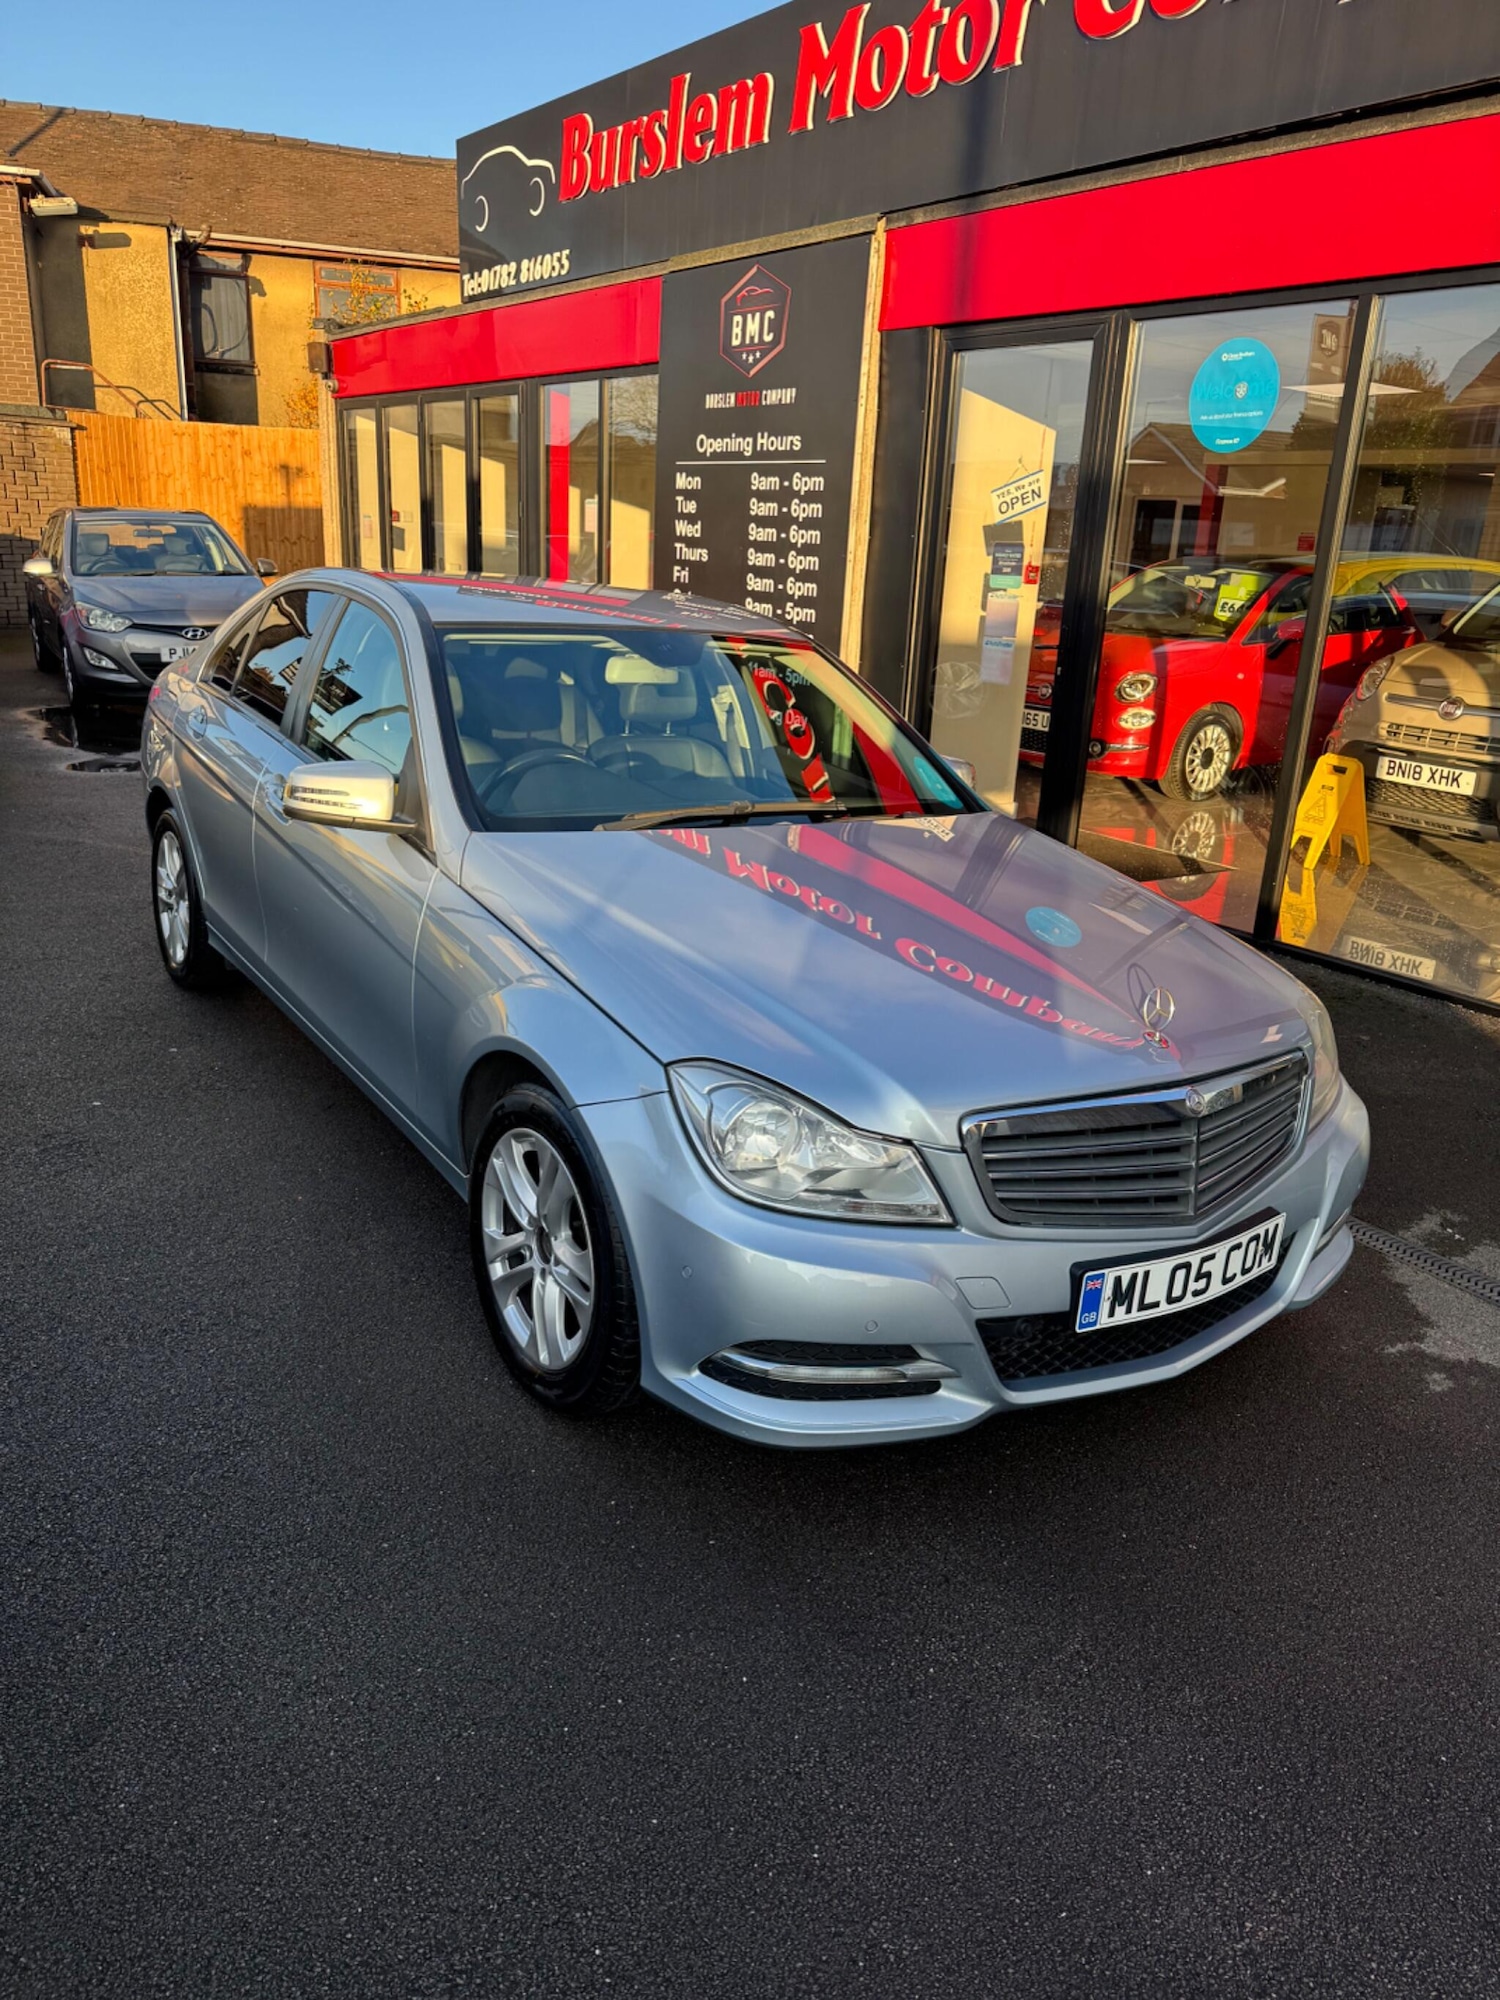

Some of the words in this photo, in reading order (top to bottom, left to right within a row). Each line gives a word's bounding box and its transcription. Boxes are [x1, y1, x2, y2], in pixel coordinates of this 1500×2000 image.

[559, 72, 775, 203] Burslem
[788, 0, 1046, 135] Motor
[462, 261, 517, 297] Tel:01782
[520, 249, 570, 284] 816055
[731, 309, 775, 346] BMC
[1195, 379, 1276, 401] Welcme
[696, 432, 753, 457] Opening
[756, 431, 801, 451] Hours
[675, 472, 701, 490] Mon
[750, 472, 780, 491] 9am
[792, 472, 824, 495] 6pm
[675, 496, 697, 514] Tue
[749, 497, 778, 516] 9am
[790, 498, 822, 522] 6pm
[998, 485, 1041, 514] OPEN
[674, 519, 701, 538] Wed
[748, 522, 777, 542] 9am
[789, 524, 821, 548] 6pm
[674, 542, 709, 563] Thurs
[747, 547, 775, 567] 9am
[787, 550, 819, 574] 6pm
[673, 565, 689, 584] Fri
[746, 573, 774, 593] 9am
[786, 576, 817, 600] 6pm
[785, 602, 816, 625] 5pm
[1386, 759, 1423, 781] BN18
[1426, 766, 1463, 788] XHK
[1221, 1223, 1279, 1286] COM
[1081, 1311, 1097, 1325] GB
